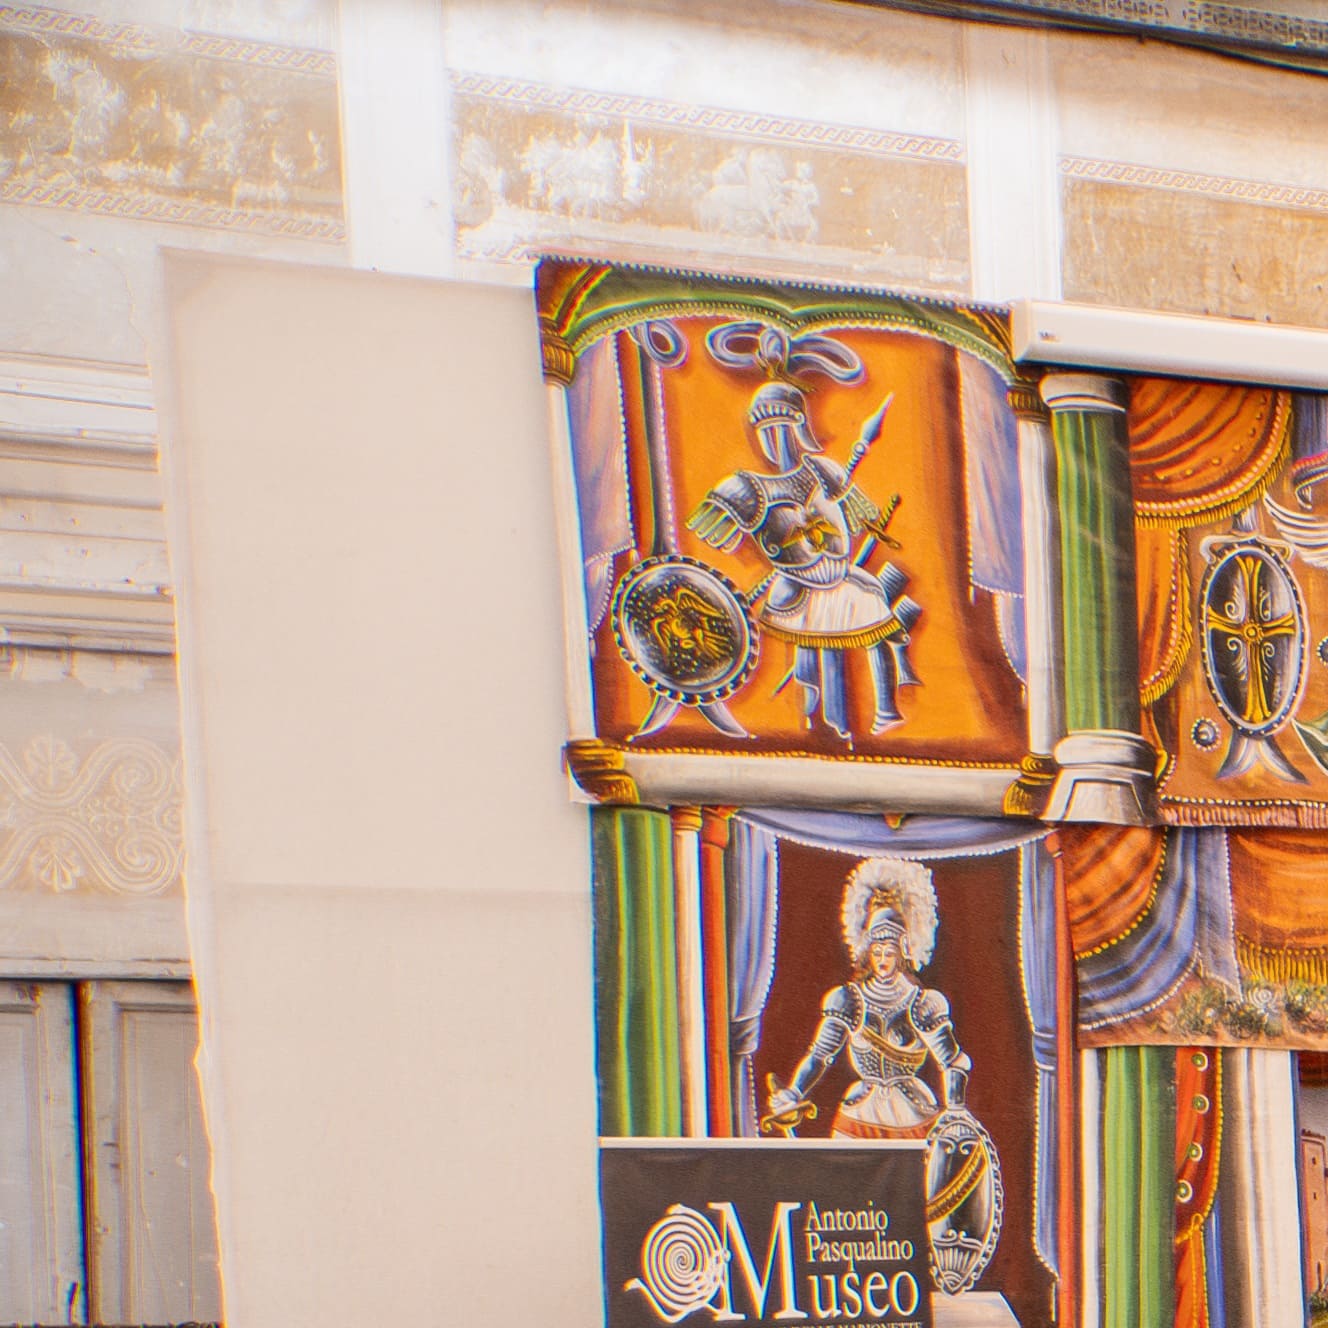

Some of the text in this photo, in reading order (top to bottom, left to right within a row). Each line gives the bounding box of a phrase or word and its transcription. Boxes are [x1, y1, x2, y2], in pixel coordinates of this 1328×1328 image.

[803, 1200, 889, 1231] Antonio
[708, 1201, 921, 1320] Museo
[804, 1232, 914, 1273] Pasqualino
